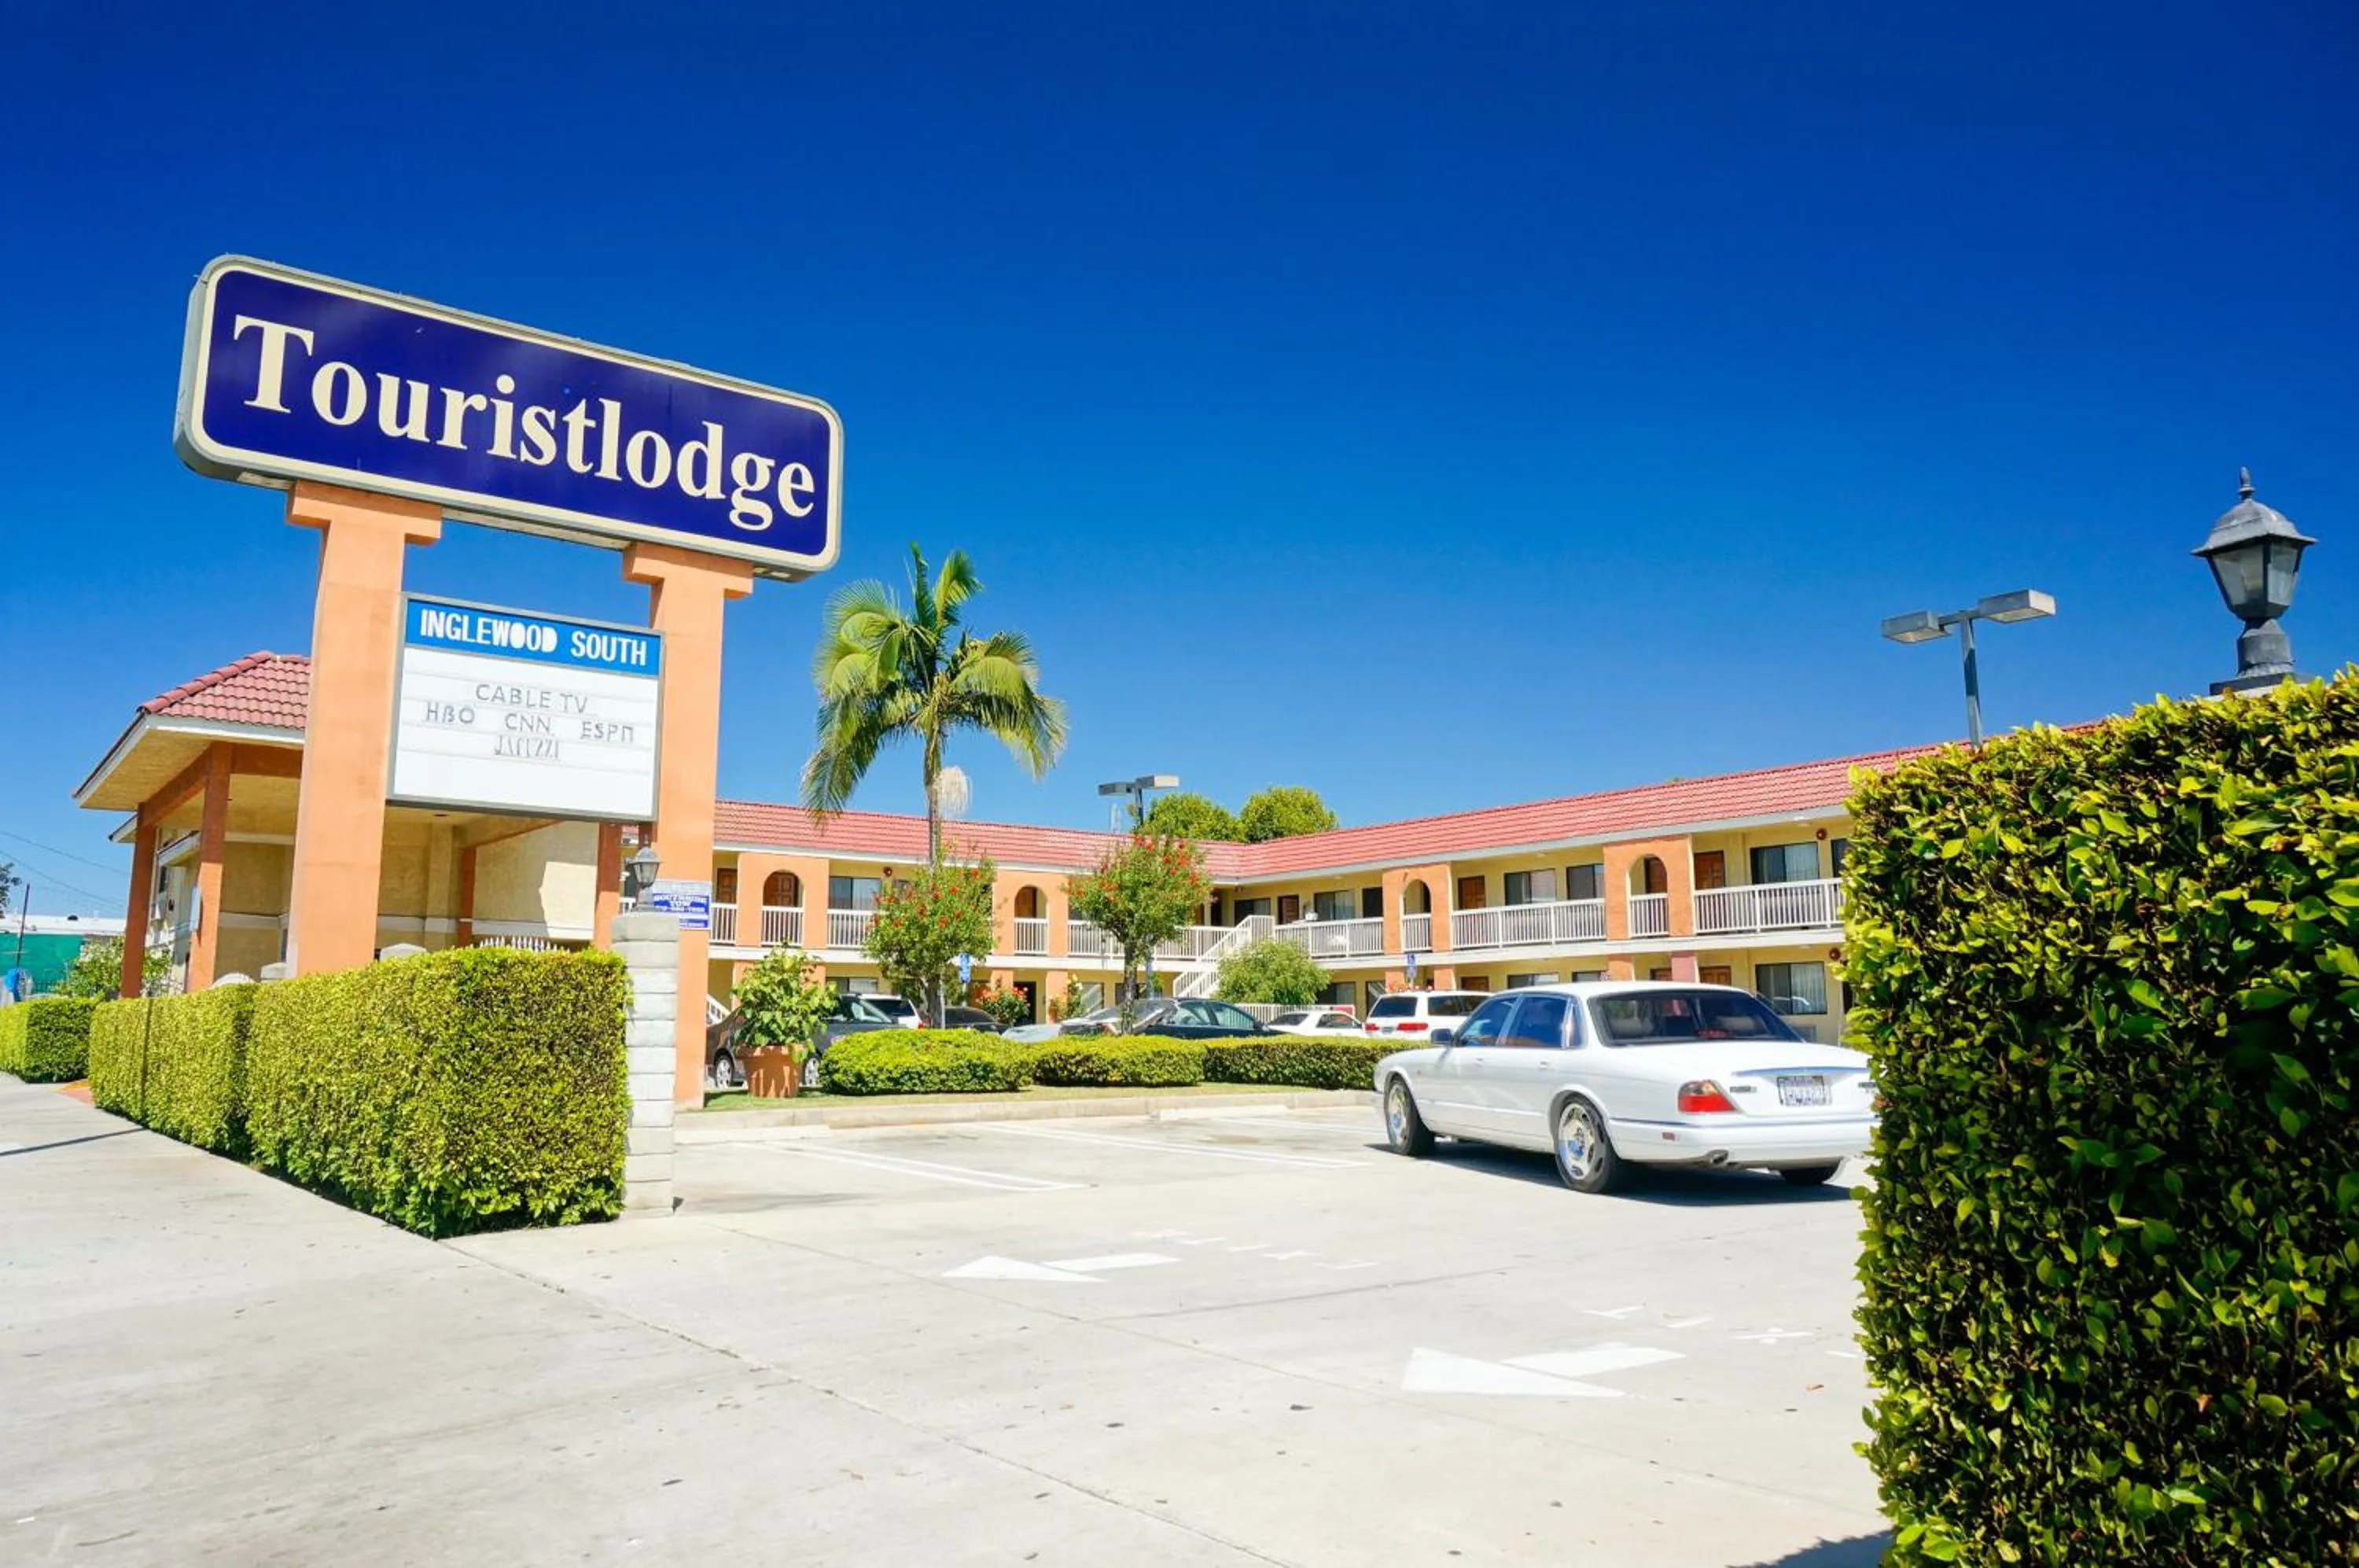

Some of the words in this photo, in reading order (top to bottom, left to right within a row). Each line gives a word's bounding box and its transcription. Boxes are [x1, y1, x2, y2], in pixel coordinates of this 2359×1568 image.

[233, 315, 815, 530] Touristlodge
[421, 609, 557, 649] INGLEWOOD
[571, 631, 646, 665] SOUTH
[425, 703, 475, 724] HBO
[505, 713, 552, 733] CNN
[476, 683, 550, 709] CABLE
[560, 694, 588, 713] TV
